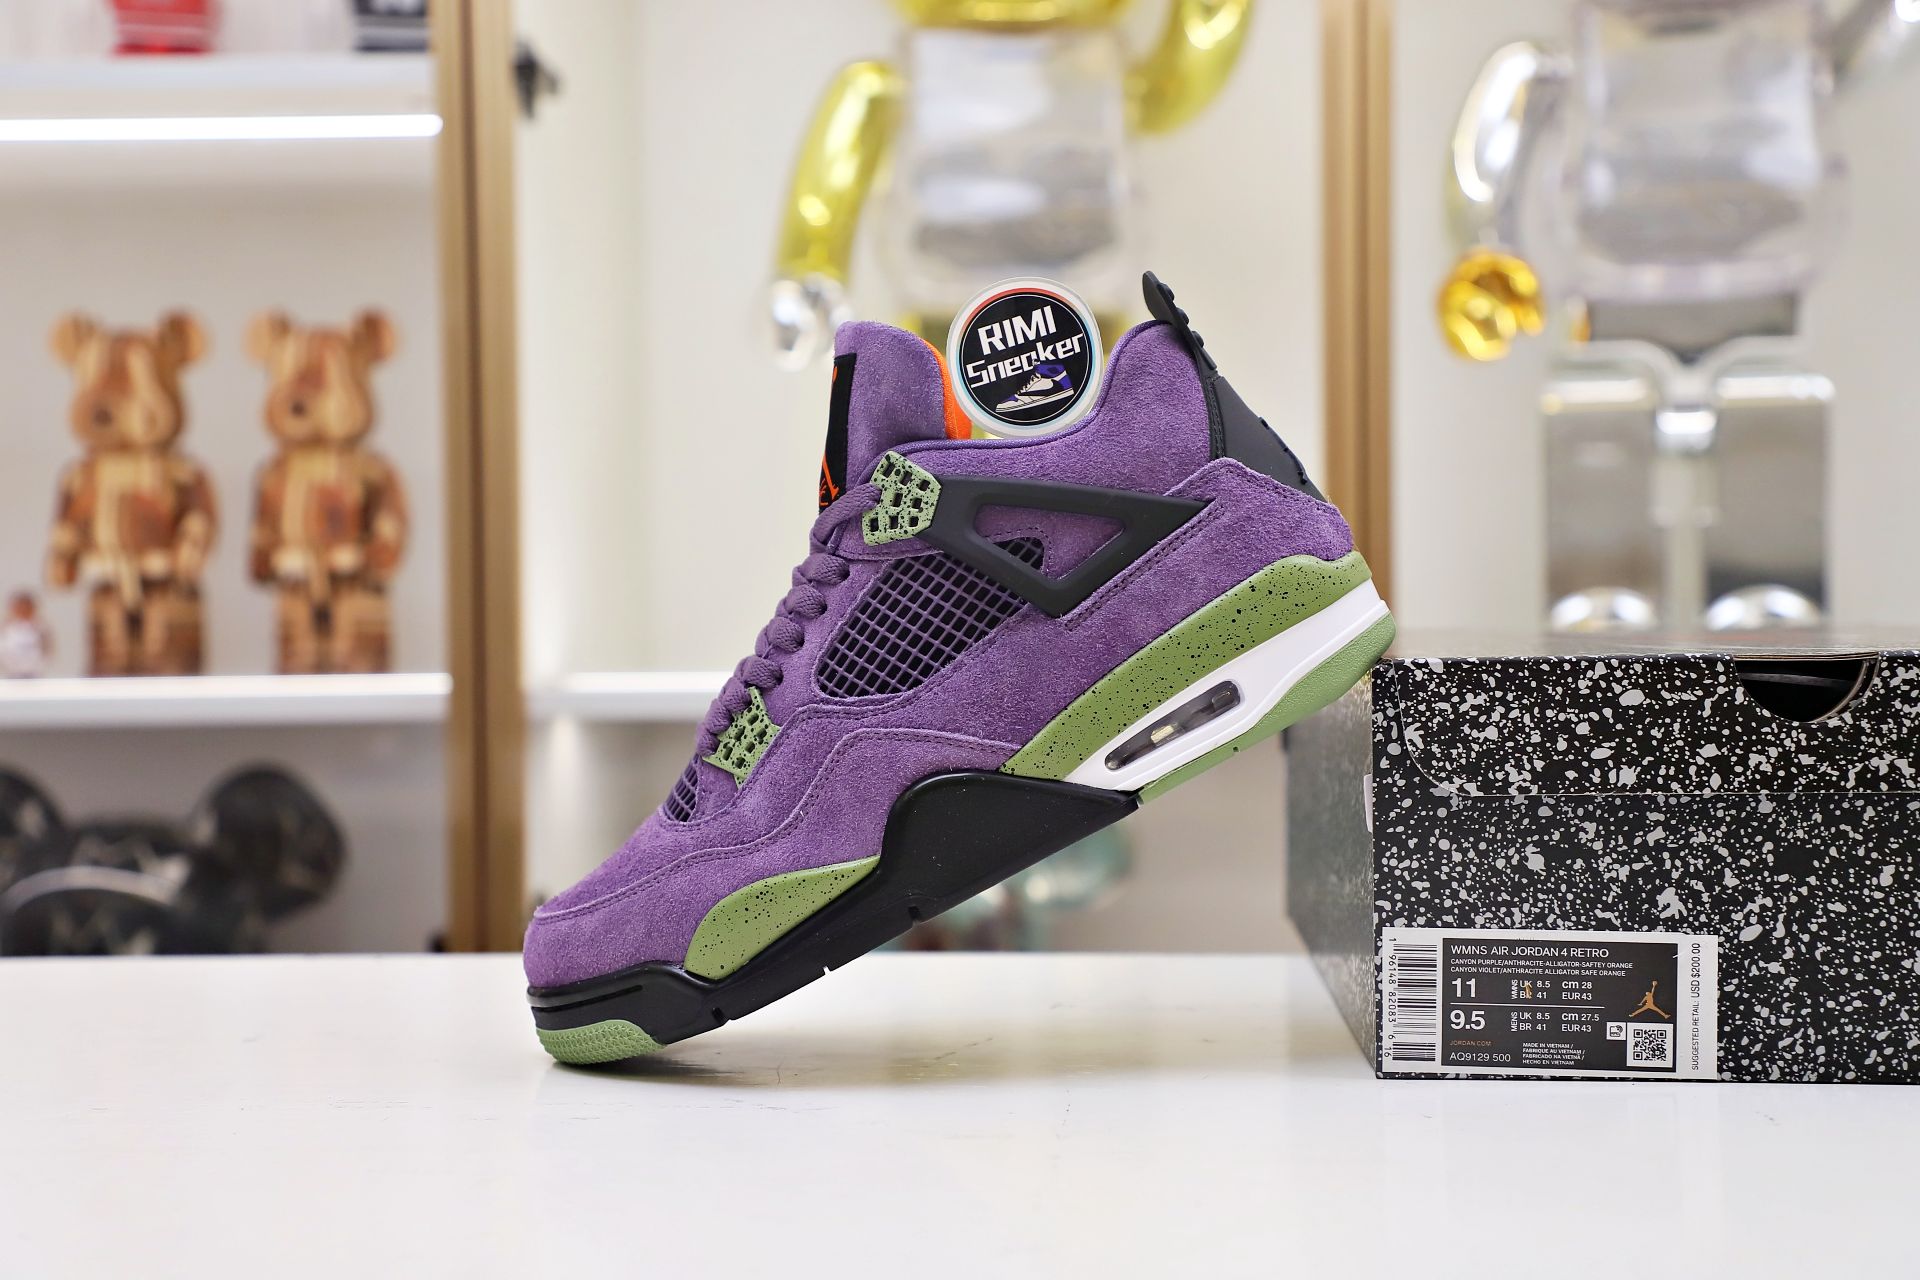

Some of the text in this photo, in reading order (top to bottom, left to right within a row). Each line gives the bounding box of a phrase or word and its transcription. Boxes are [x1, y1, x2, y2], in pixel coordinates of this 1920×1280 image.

[977, 305, 1057, 355] RIMI
[966, 333, 1084, 388] Sneaker
[1451, 945, 1609, 958] WMNS AIR JORDAN 4 RETRO
[1388, 954, 1397, 985] 96148
[1479, 967, 1543, 975] VIOLET/ANTHRACITE
[1451, 977, 1476, 998] 11
[1511, 979, 1519, 999] WMNS
[1520, 980, 1551, 988] UK 8.5
[1562, 981, 1593, 989] cm 28
[1536, 991, 1548, 999] 41
[1562, 992, 1592, 1001] EUR 43
[1388, 991, 1397, 1023] 82083
[1690, 942, 1701, 1071] SUGGESTED RETAIL: USD $200.00
[1450, 1009, 1486, 1030] 9.5
[1510, 1011, 1518, 1032] MENS
[1519, 1012, 1551, 1020] UK 8.5
[1561, 1013, 1600, 1022] cm 27.5
[1519, 1023, 1547, 1031] BR 41
[1561, 1023, 1592, 1033] EUR 43
[1449, 1052, 1511, 1062] AQ9129 500
